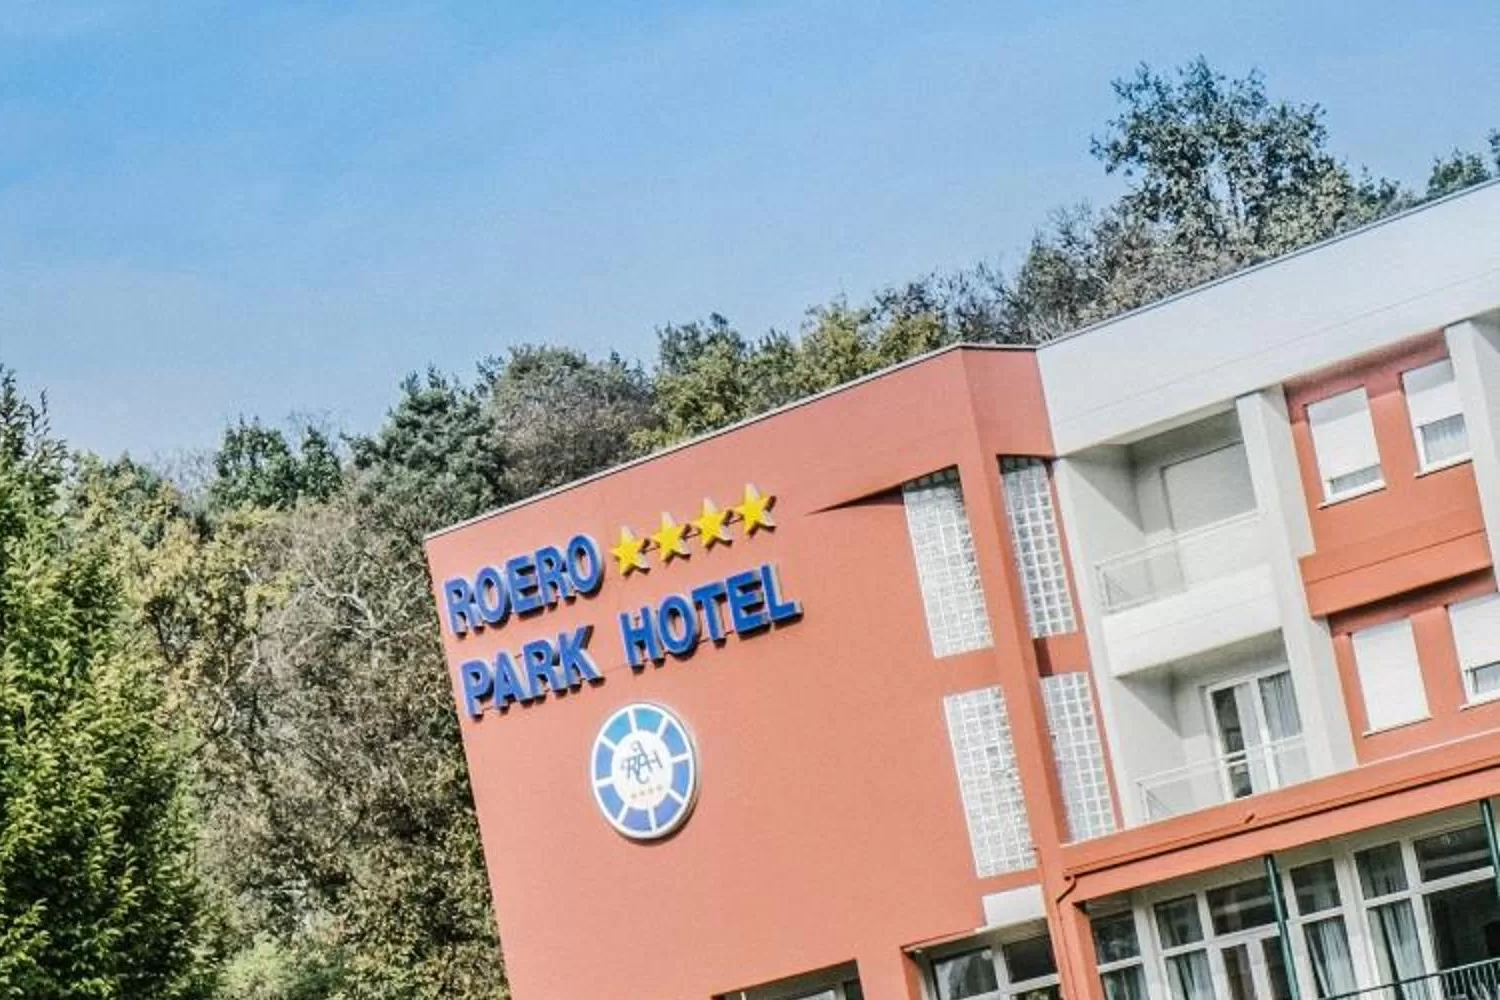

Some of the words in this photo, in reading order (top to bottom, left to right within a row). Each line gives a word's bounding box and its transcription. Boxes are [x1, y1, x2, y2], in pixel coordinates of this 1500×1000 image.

[444, 534, 603, 636] ROERO
[461, 625, 604, 719] PARK
[618, 563, 802, 671] HOTEL
